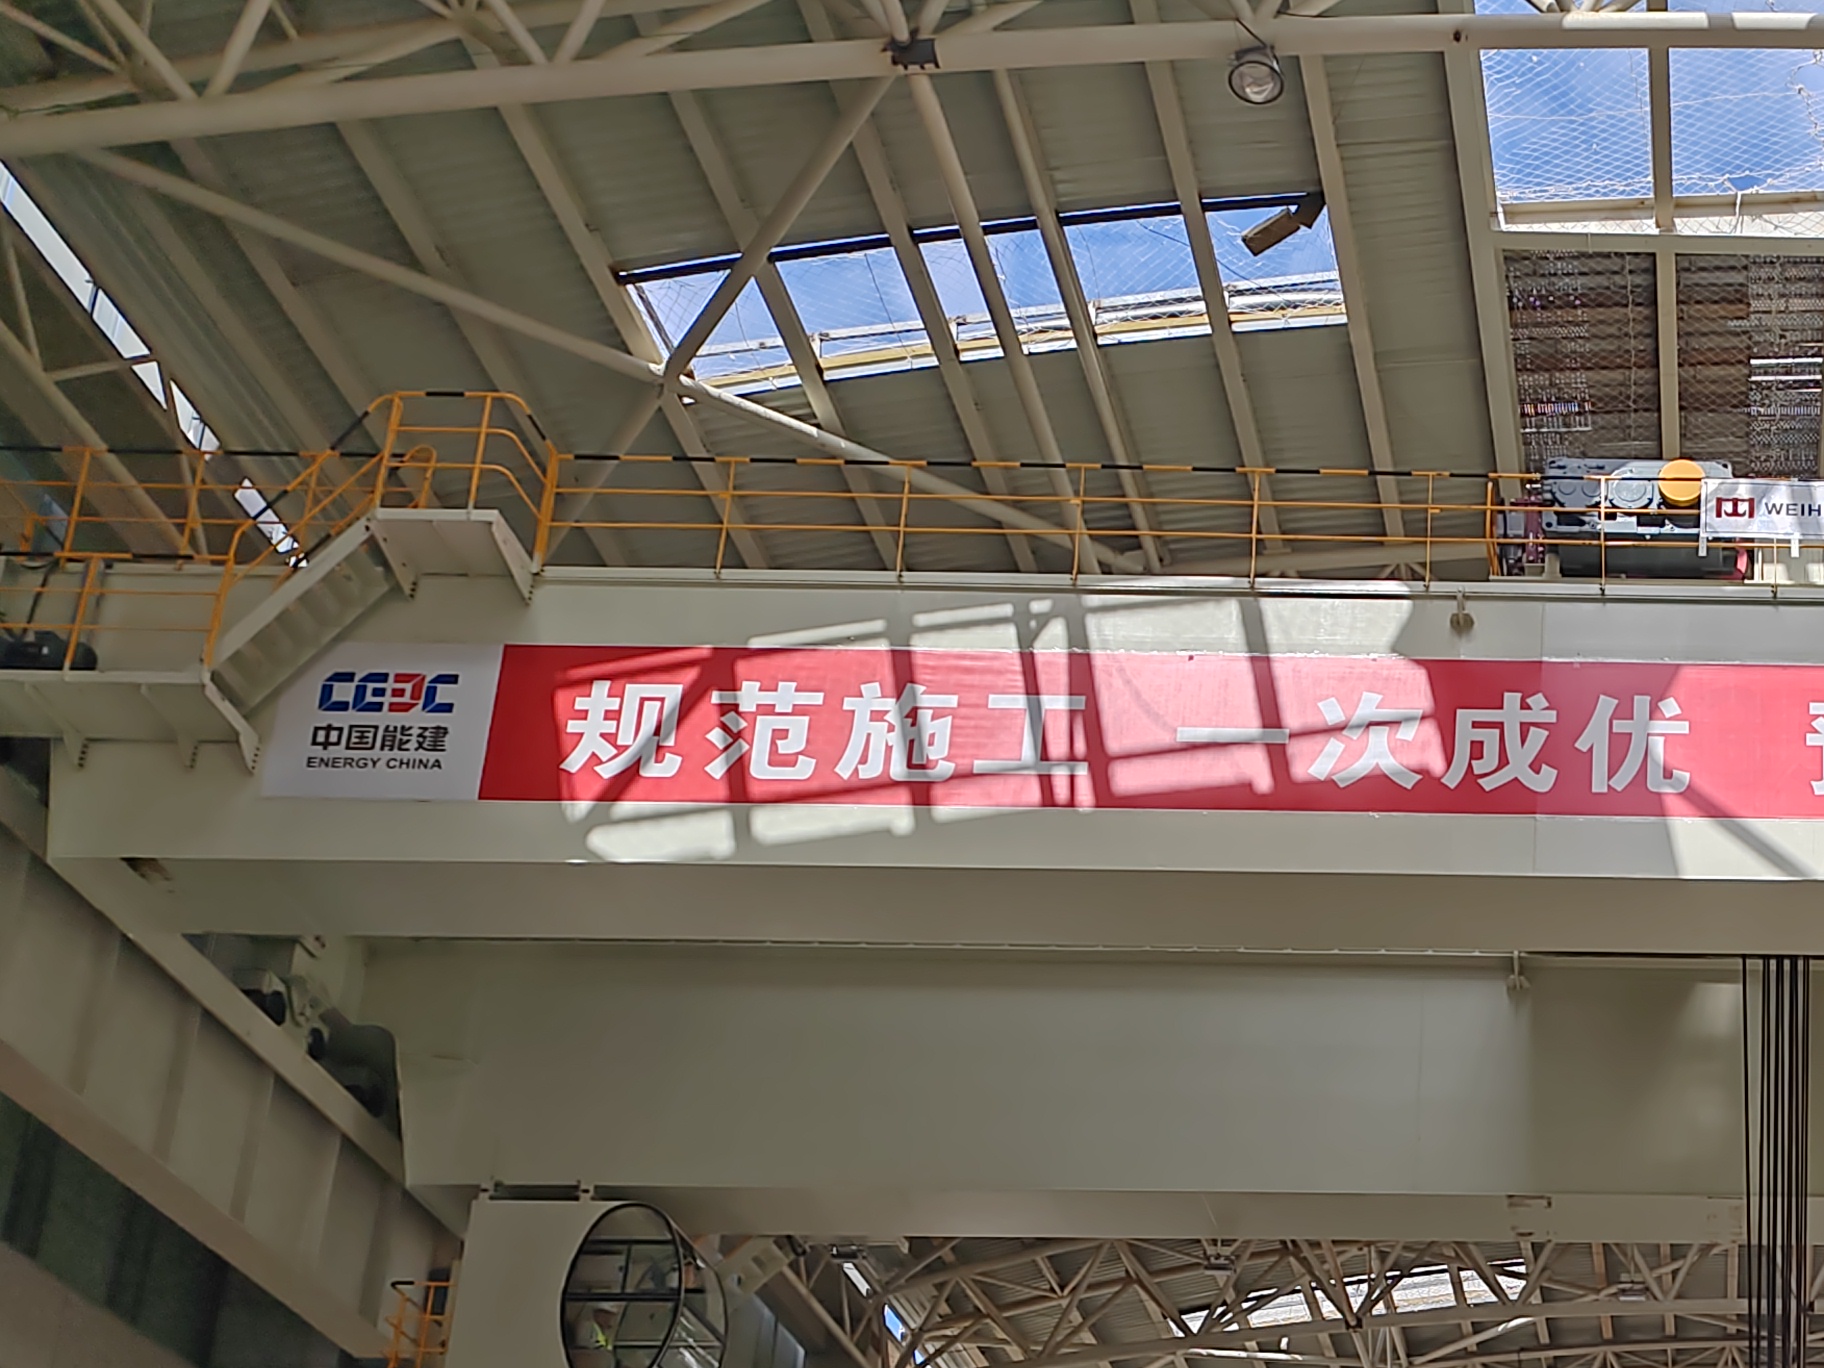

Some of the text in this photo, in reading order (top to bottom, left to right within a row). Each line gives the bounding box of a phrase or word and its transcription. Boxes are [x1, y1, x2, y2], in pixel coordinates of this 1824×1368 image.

[310, 723, 449, 752] 中国能建
[559, 679, 1088, 782] 规范施工
[1176, 690, 1691, 795] 一次成优
[306, 757, 443, 770] ENERGY CHINA
